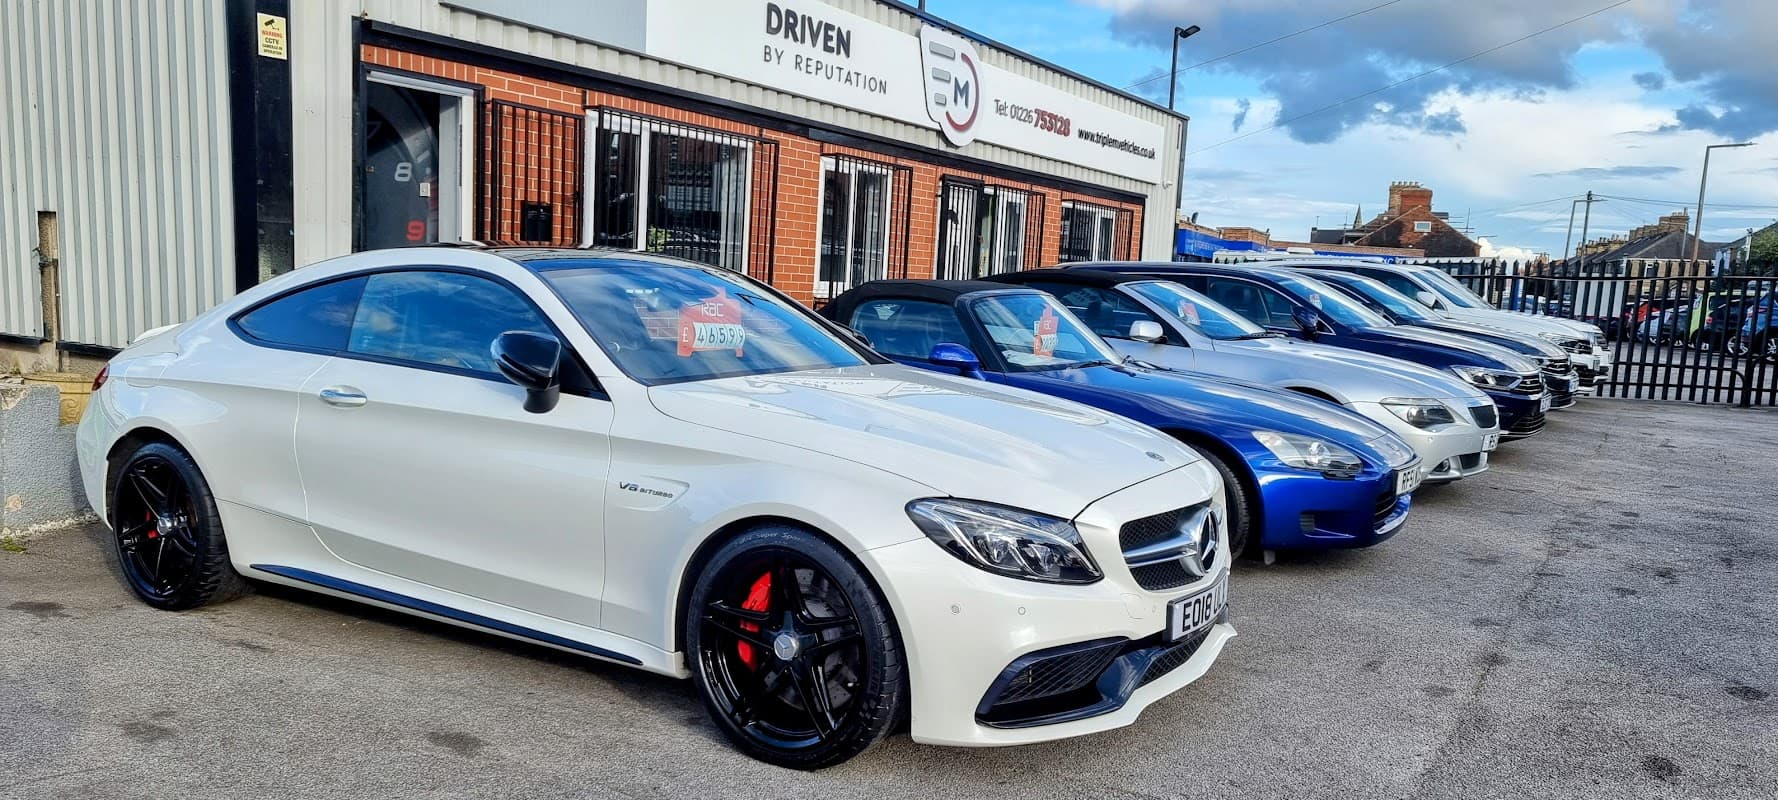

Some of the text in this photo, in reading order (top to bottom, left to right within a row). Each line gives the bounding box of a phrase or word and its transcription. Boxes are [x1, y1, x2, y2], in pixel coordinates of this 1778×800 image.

[265, 37, 279, 45] CCTV
[766, 2, 851, 59] DRIVEN
[763, 45, 887, 95] BY REPUTATION
[953, 76, 970, 109] M
[1010, 104, 1034, 124] 01226
[1034, 108, 1072, 137] 753128
[1077, 128, 1156, 160] www.triplemvehicles.co.uk
[394, 161, 413, 182] 8
[406, 220, 426, 241] 9
[697, 326, 745, 344] 46599
[619, 481, 673, 498] V8 BITURBO
